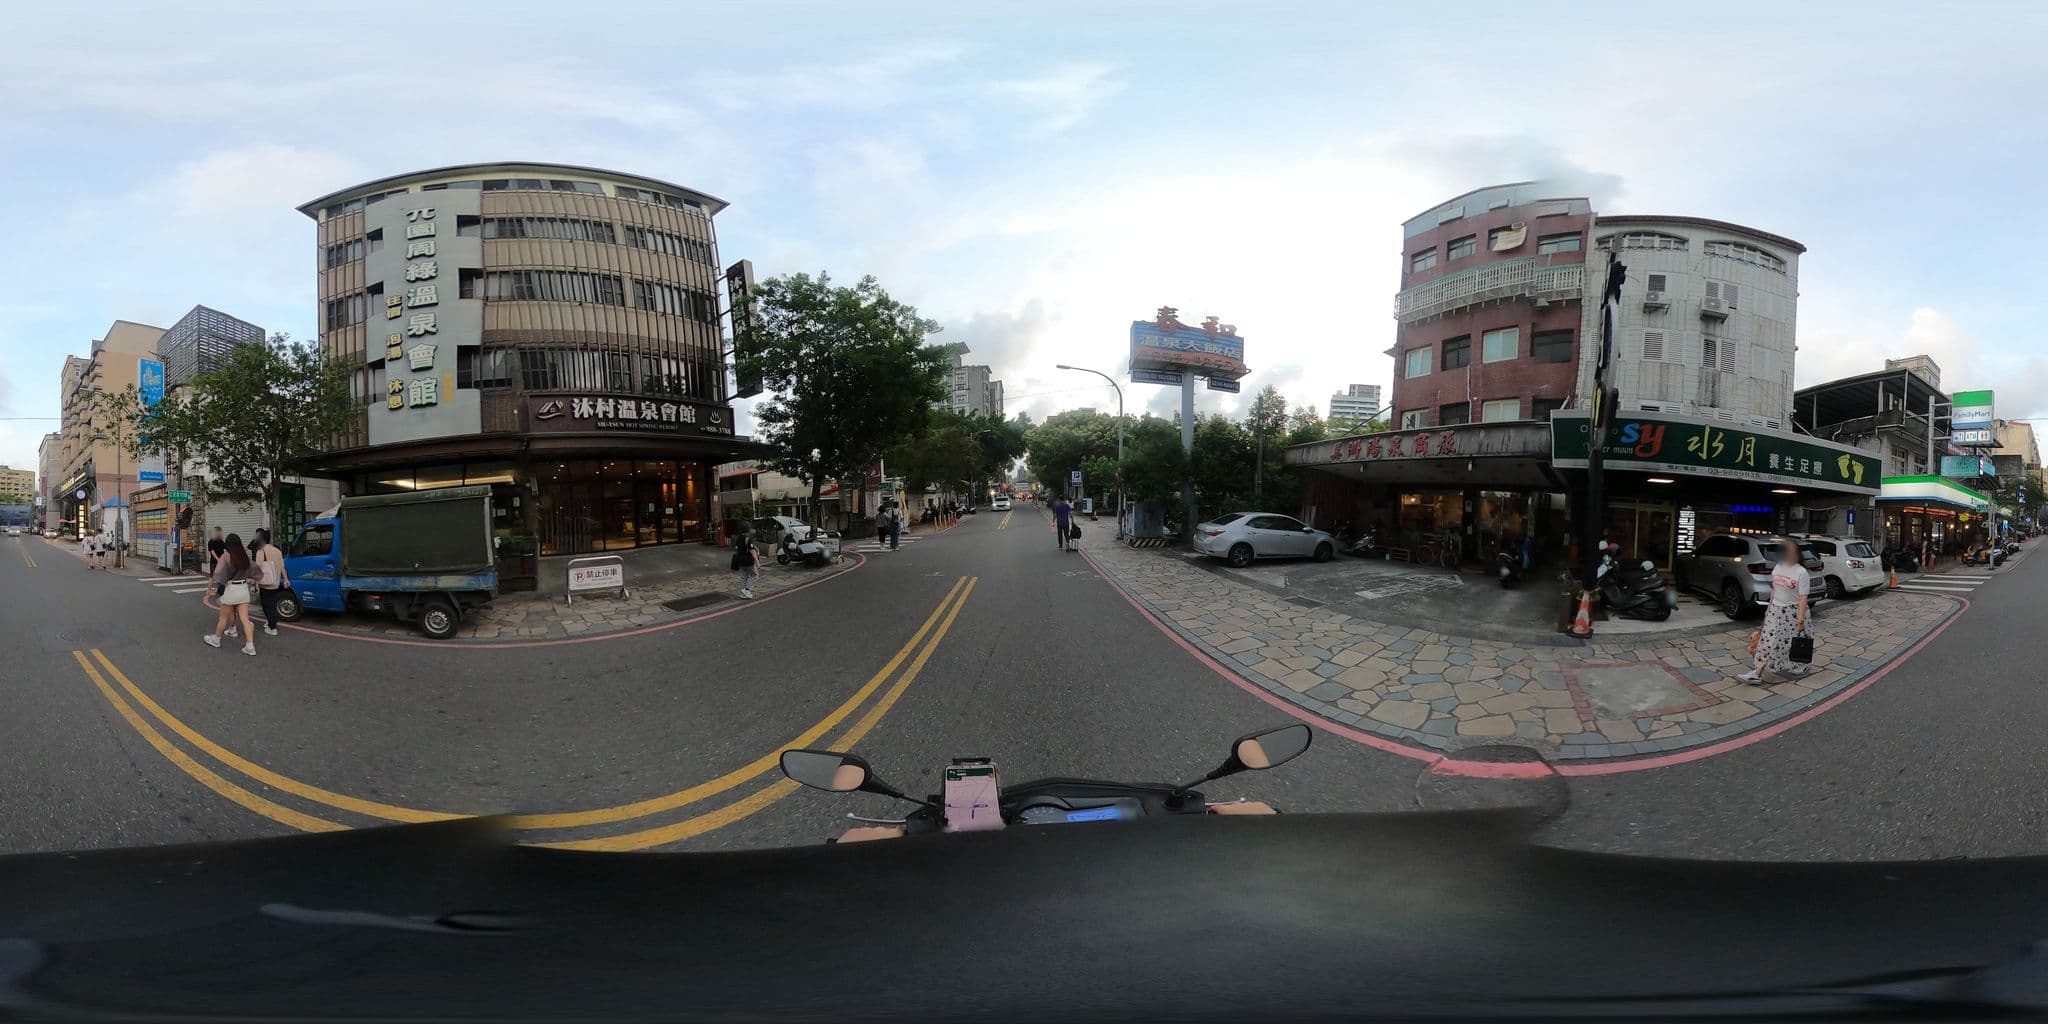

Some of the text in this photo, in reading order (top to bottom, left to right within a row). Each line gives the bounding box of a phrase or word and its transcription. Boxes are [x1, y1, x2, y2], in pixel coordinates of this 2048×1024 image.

[385, 295, 404, 410] 住宿 泡湯 休息
[1139, 335, 1241, 360] 溫泉大飯店
[571, 397, 697, 424] 沐村溫泉會館
[1953, 410, 1991, 419] FamilyMart
[1687, 424, 1757, 467] 水月
[1768, 452, 1823, 477] 養生足療
[586, 568, 617, 578] 禁止停車
